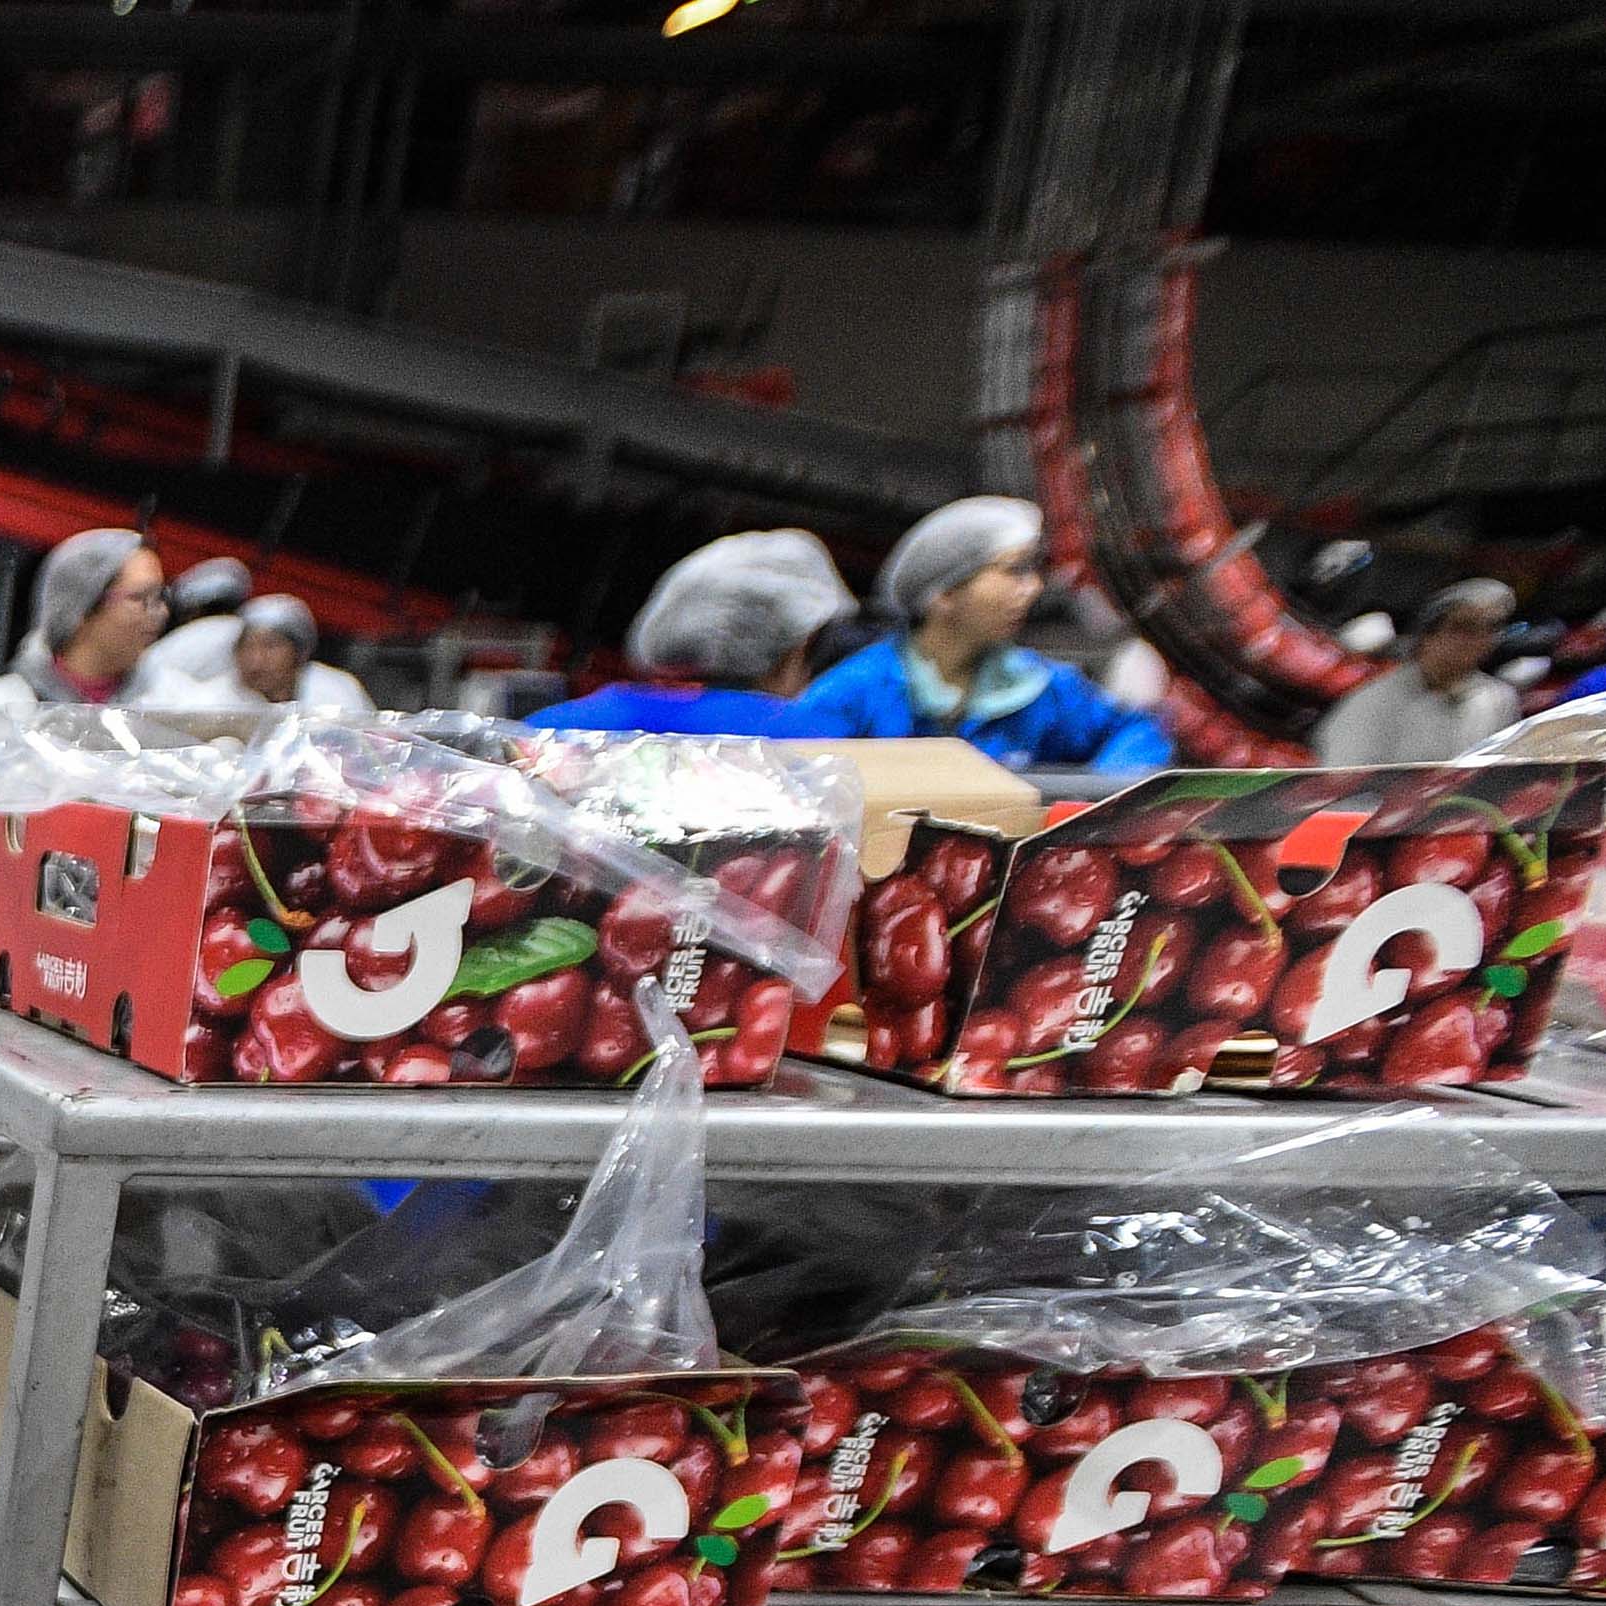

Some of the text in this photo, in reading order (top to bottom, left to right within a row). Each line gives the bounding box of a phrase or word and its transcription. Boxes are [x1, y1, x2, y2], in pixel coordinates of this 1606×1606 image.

[1082, 920, 1117, 982] FRUIT
[1101, 891, 1144, 979] GARCES
[285, 1491, 310, 1550] FRUIT
[304, 1463, 333, 1546] GARCES
